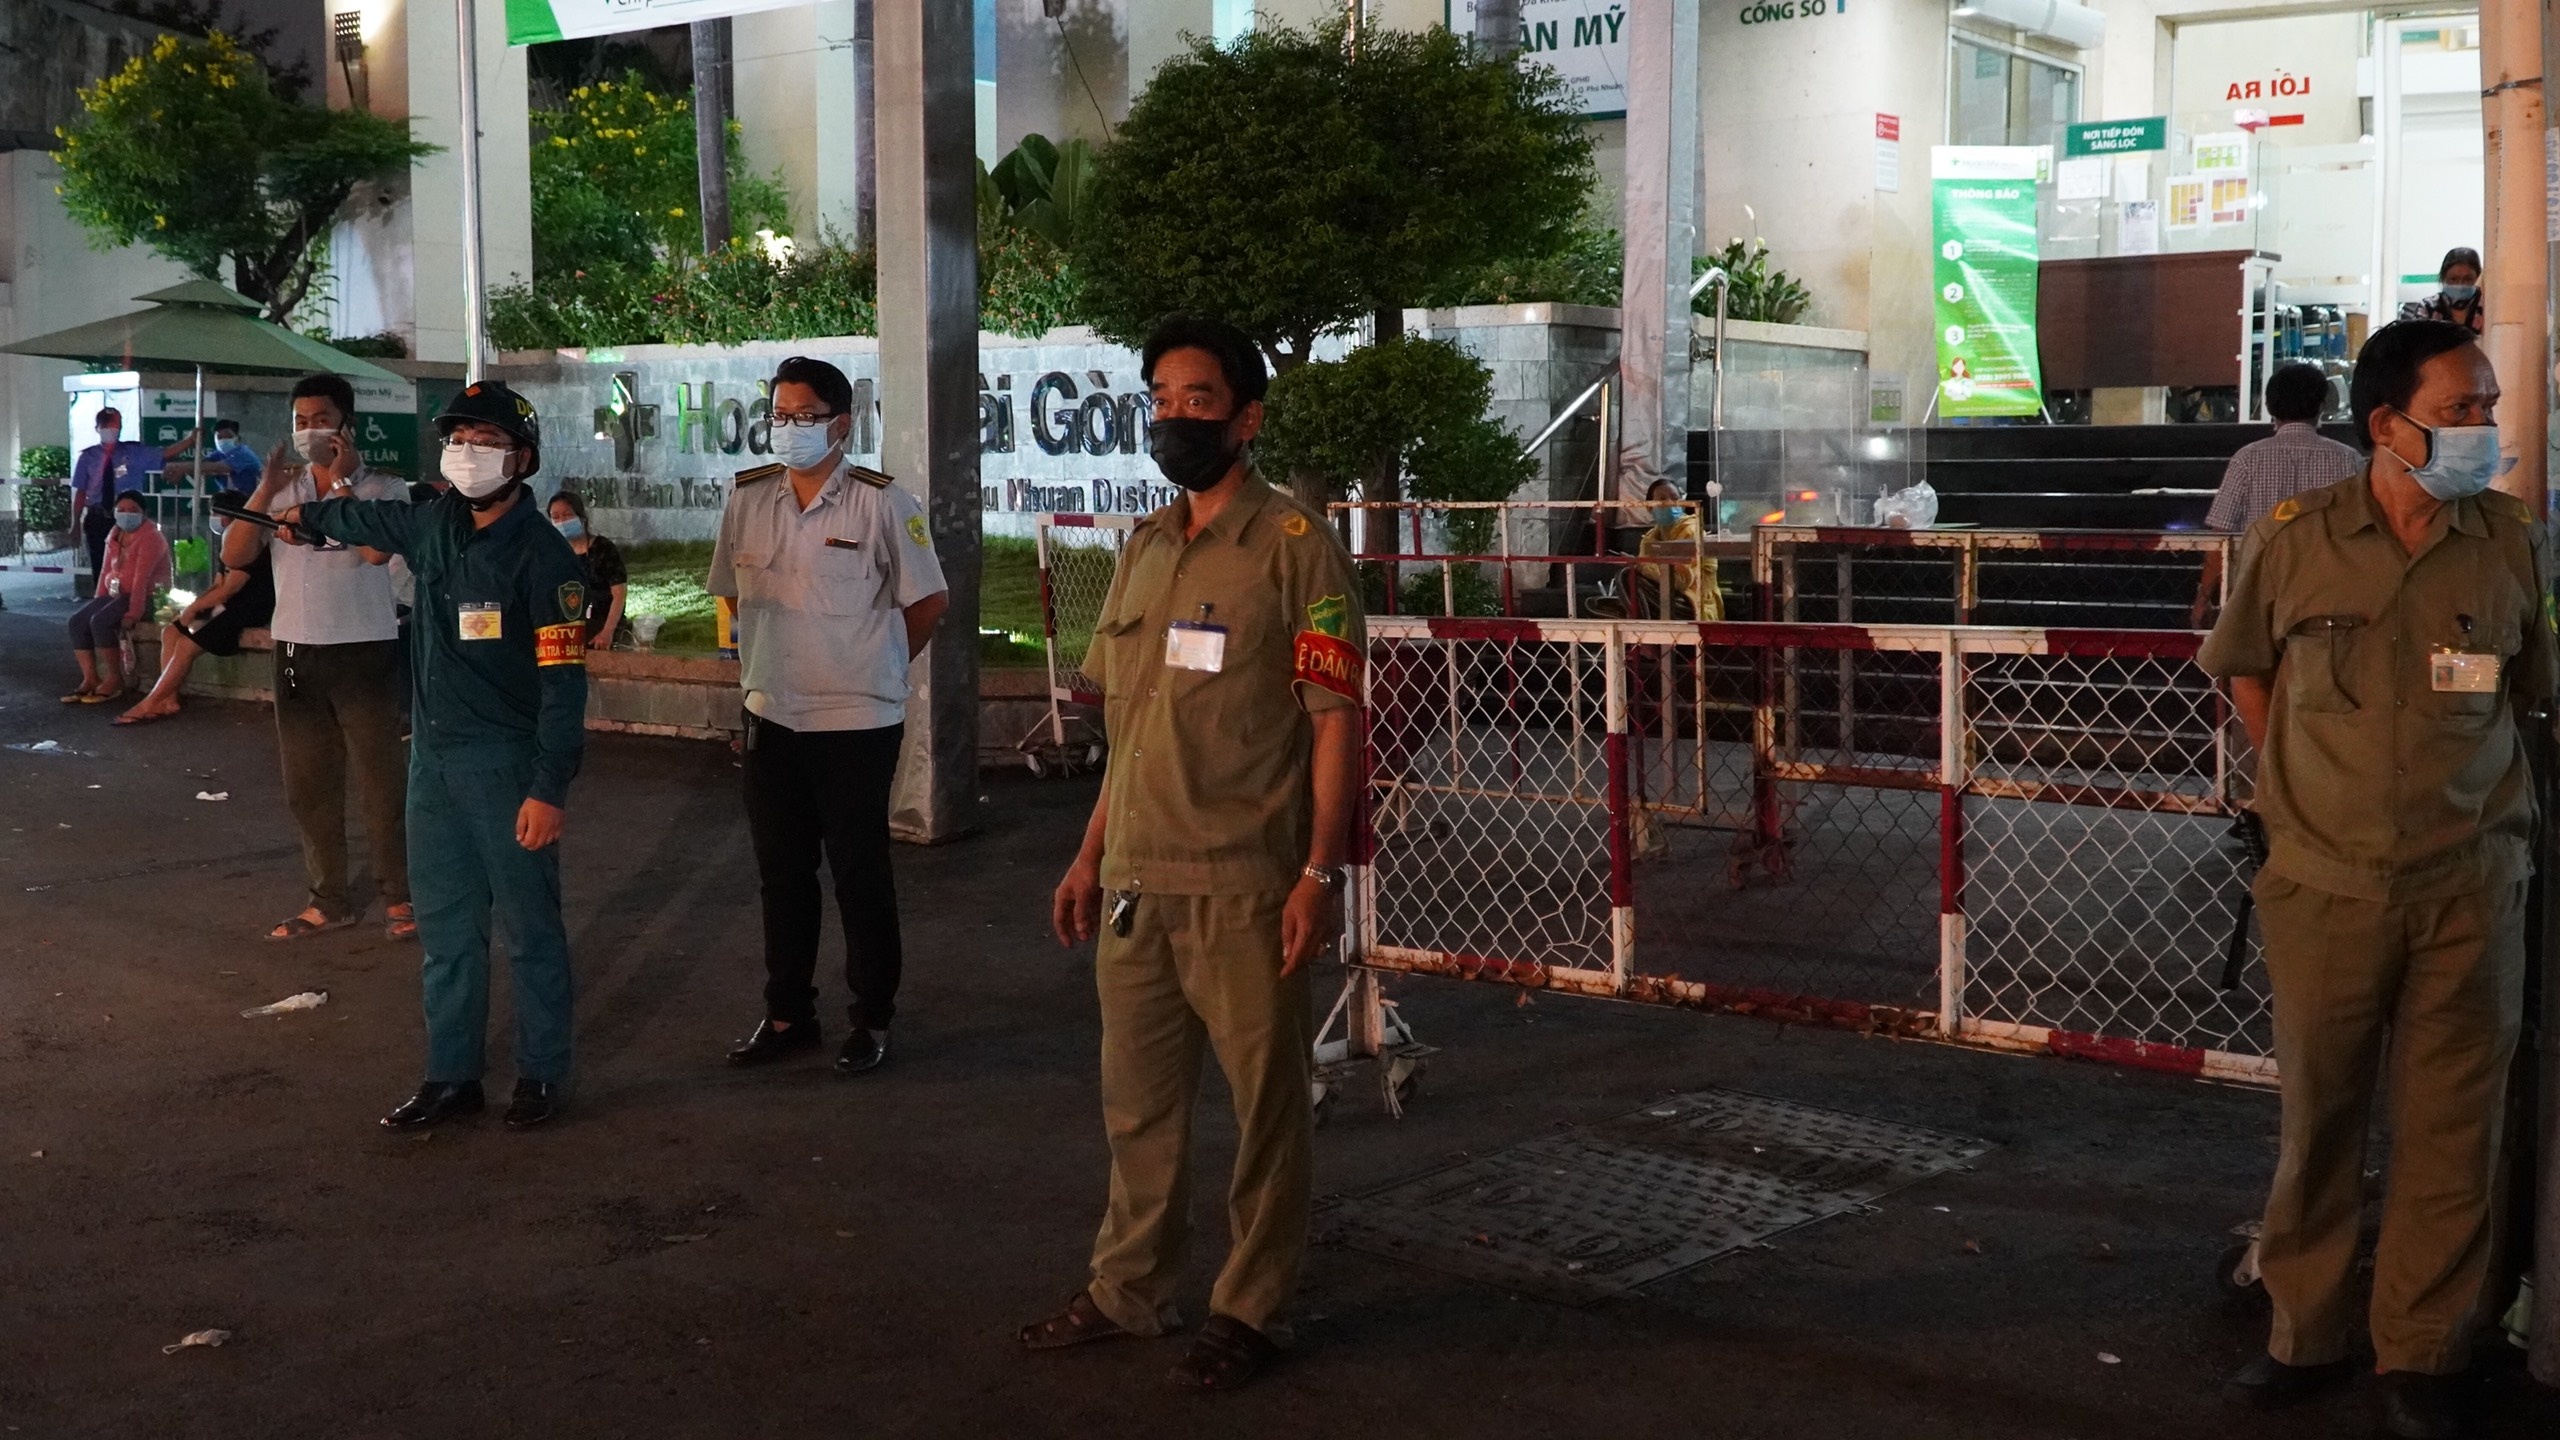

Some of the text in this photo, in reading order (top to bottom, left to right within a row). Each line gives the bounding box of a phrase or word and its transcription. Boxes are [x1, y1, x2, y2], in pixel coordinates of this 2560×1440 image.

[1574, 4, 1626, 47] MỸ
[1952, 187, 2020, 200] THÔNG BÁO
[1950, 287, 1957, 299] 2
[1952, 331, 1959, 342] 3
[678, 379, 774, 455] Hoà
[1030, 370, 1150, 456] Gòn
[1007, 478, 1085, 513] Nhuan
[539, 628, 576, 641] DQTV
[546, 645, 560, 657] TRA
[1295, 642, 1308, 672] Ệ
[1310, 648, 1350, 682] DÂN
